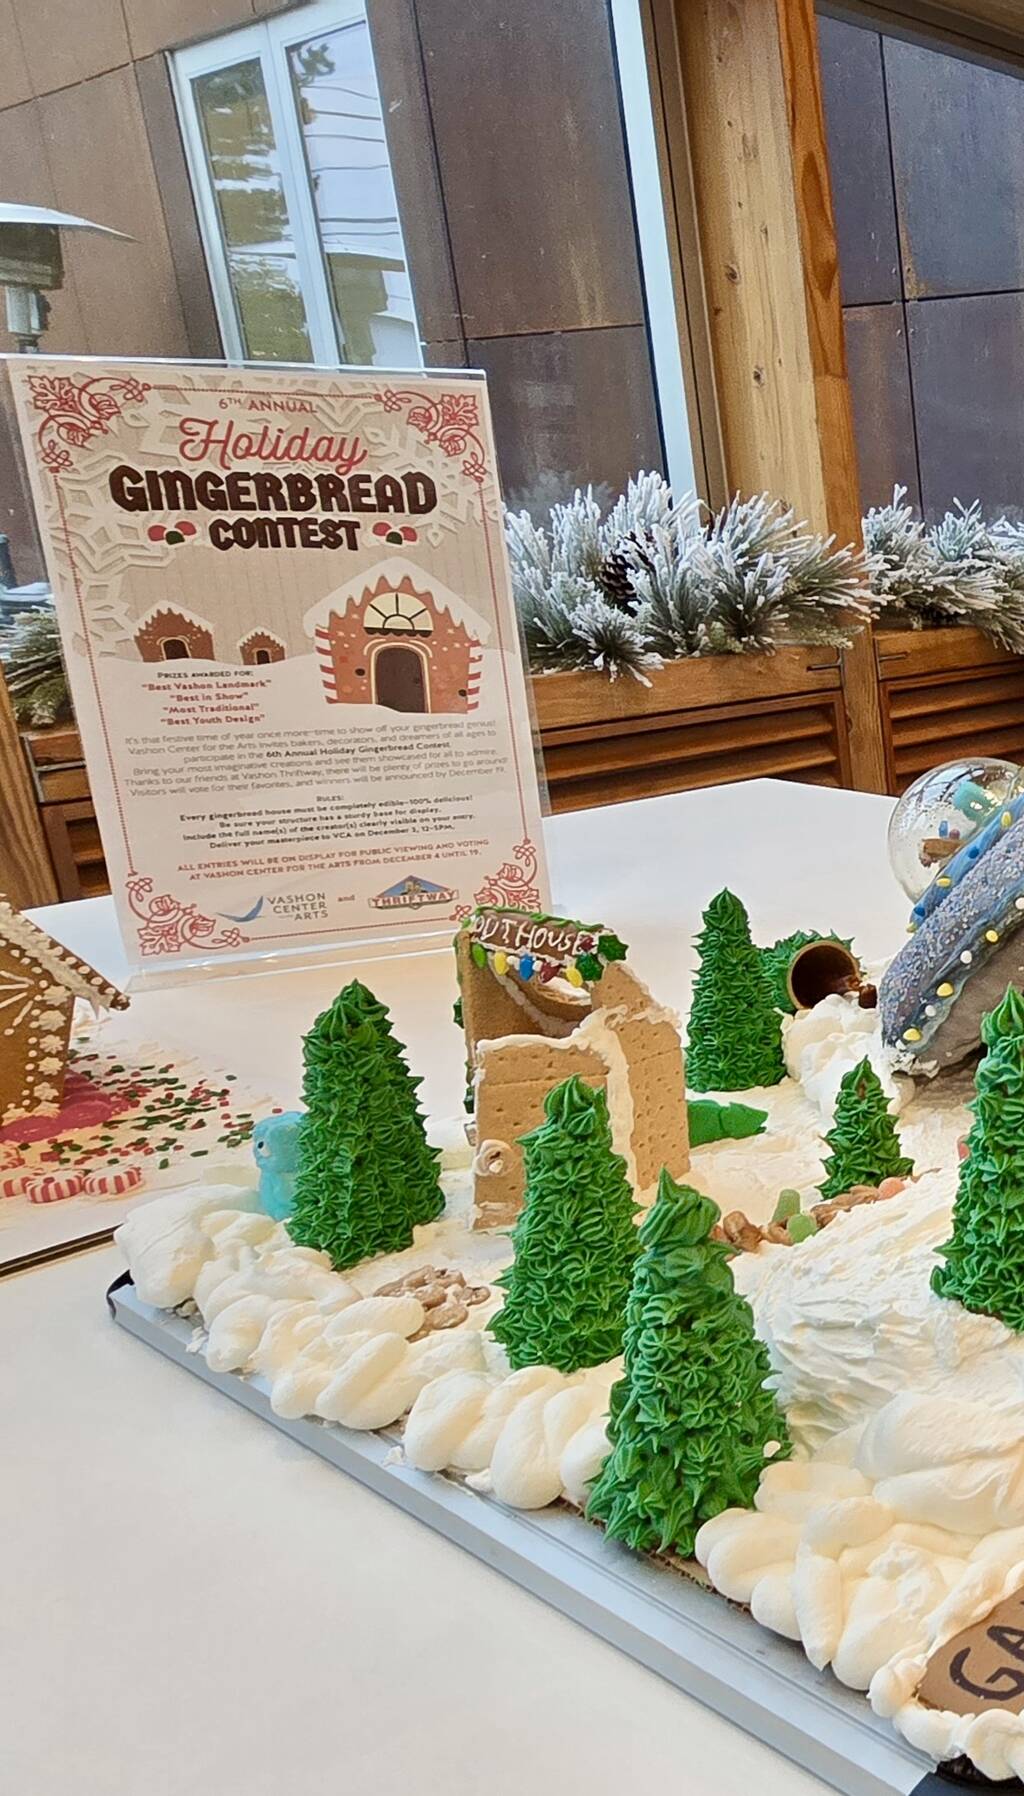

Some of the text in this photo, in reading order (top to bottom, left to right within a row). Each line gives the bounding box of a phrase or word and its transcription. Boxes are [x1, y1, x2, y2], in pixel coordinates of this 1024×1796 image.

[248, 400, 317, 414] ANNUAL
[179, 417, 367, 476] Holiday
[108, 463, 438, 516] GINGERBREAD
[208, 516, 361, 552] CONTEST
[172, 681, 214, 690] Vashon
[192, 716, 222, 724] Youth
[233, 732, 254, 740] year
[390, 724, 410, 733] your
[127, 745, 166, 754] Vashon
[168, 743, 200, 752] Center
[184, 752, 234, 763] participate
[284, 747, 318, 756] Annual
[320, 745, 356, 756] Holiday
[358, 742, 414, 754] Gingerbread
[416, 740, 450, 749] Contest
[179, 812, 206, 822] Every
[208, 808, 262, 820] gingerbread
[264, 806, 292, 815] house
[294, 804, 315, 813] must
[330, 800, 376, 812] completely
[254, 818, 276, 827] your
[278, 814, 318, 824] structure
[344, 810, 371, 821] sturdy
[372, 809, 392, 817] base
[182, 831, 216, 840] Include
[358, 818, 388, 829] clearly
[390, 816, 418, 825] visible
[432, 814, 450, 823] your
[209, 839, 242, 848] Deliver
[244, 838, 265, 848] your
[266, 833, 320, 846] masterpiece
[332, 831, 352, 839] VCA
[368, 826, 409, 836] December
[176, 862, 196, 871] ALL
[197, 859, 238, 869] ENTRIES
[240, 857, 265, 866] WILL
[280, 854, 296, 862] ON
[298, 851, 336, 860] DISPLAY
[338, 849, 358, 857] FOR
[359, 846, 392, 856] PUBLIC
[392, 842, 434, 853] VIEWING
[434, 841, 455, 849] AND
[456, 838, 490, 847] VOTING
[202, 869, 244, 879] VASHON
[246, 865, 284, 875] CENTER
[286, 863, 306, 872] FOR
[308, 862, 326, 870] THE
[328, 859, 352, 868] ARTS
[352, 857, 381, 866] FROM
[382, 852, 432, 863] DECEMBER
[442, 849, 468, 858] UNTIL
[267, 892, 326, 905] VASHON
[273, 902, 327, 914] CENTER
[338, 890, 456, 907] and THRIFTWAY
[294, 910, 328, 922] ARTS
[474, 914, 591, 956] OUTHOUSE
